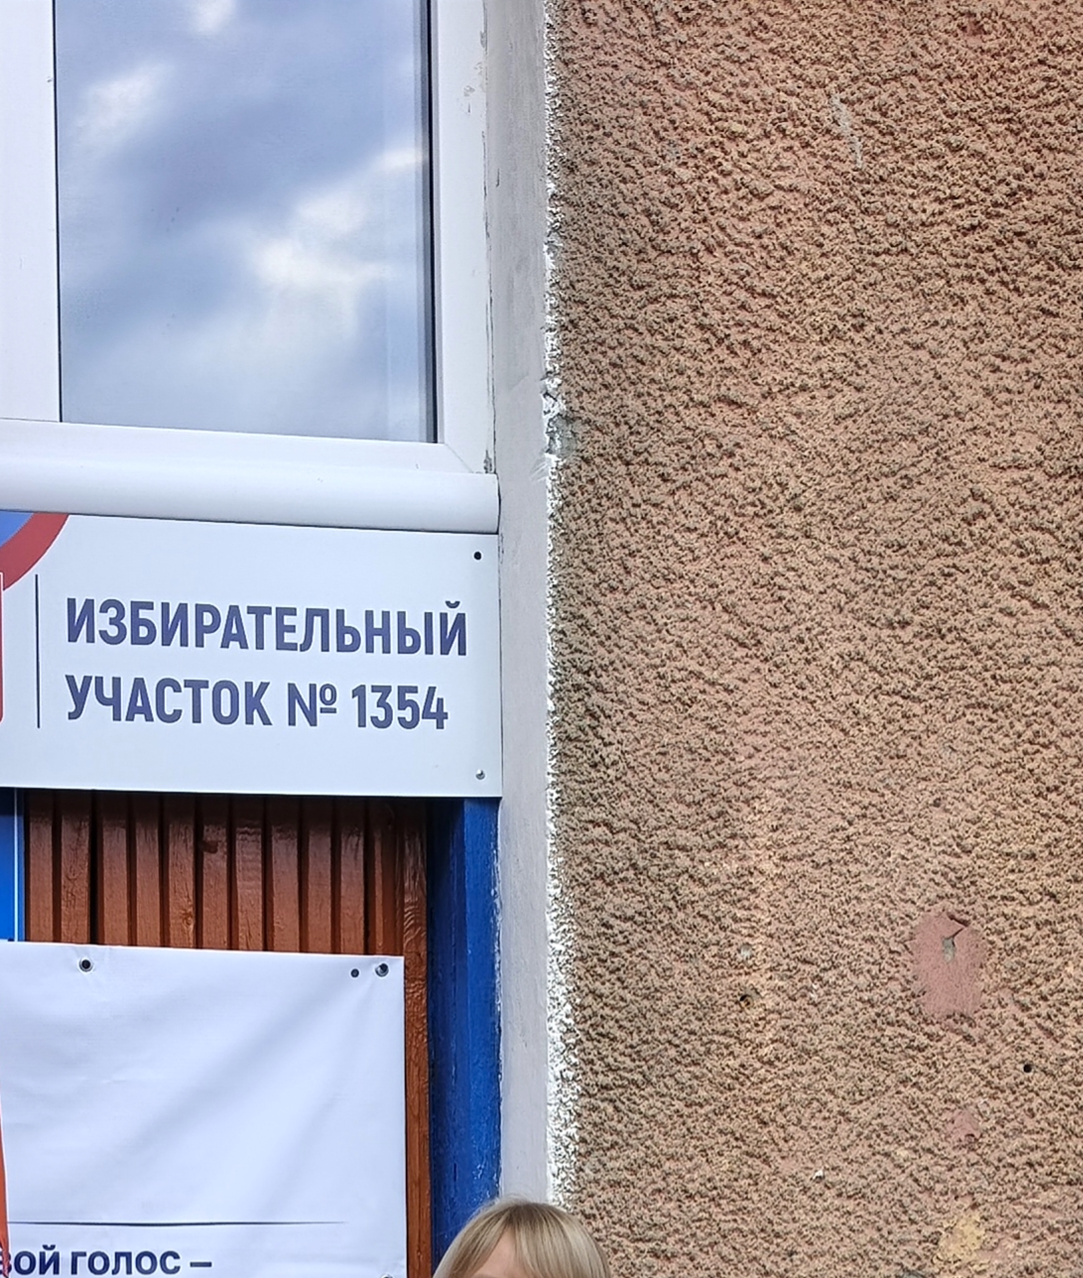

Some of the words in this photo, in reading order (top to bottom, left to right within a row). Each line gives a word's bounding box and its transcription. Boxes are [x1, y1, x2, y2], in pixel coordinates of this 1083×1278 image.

[66, 597, 467, 656] ИЗБИРАТЕЛЬНЫЙ
[65, 674, 273, 726] УЧАСТОК
[287, 682, 338, 726] №
[351, 685, 449, 730] 1354
[70, 1250, 181, 1276] ГОЛОС
